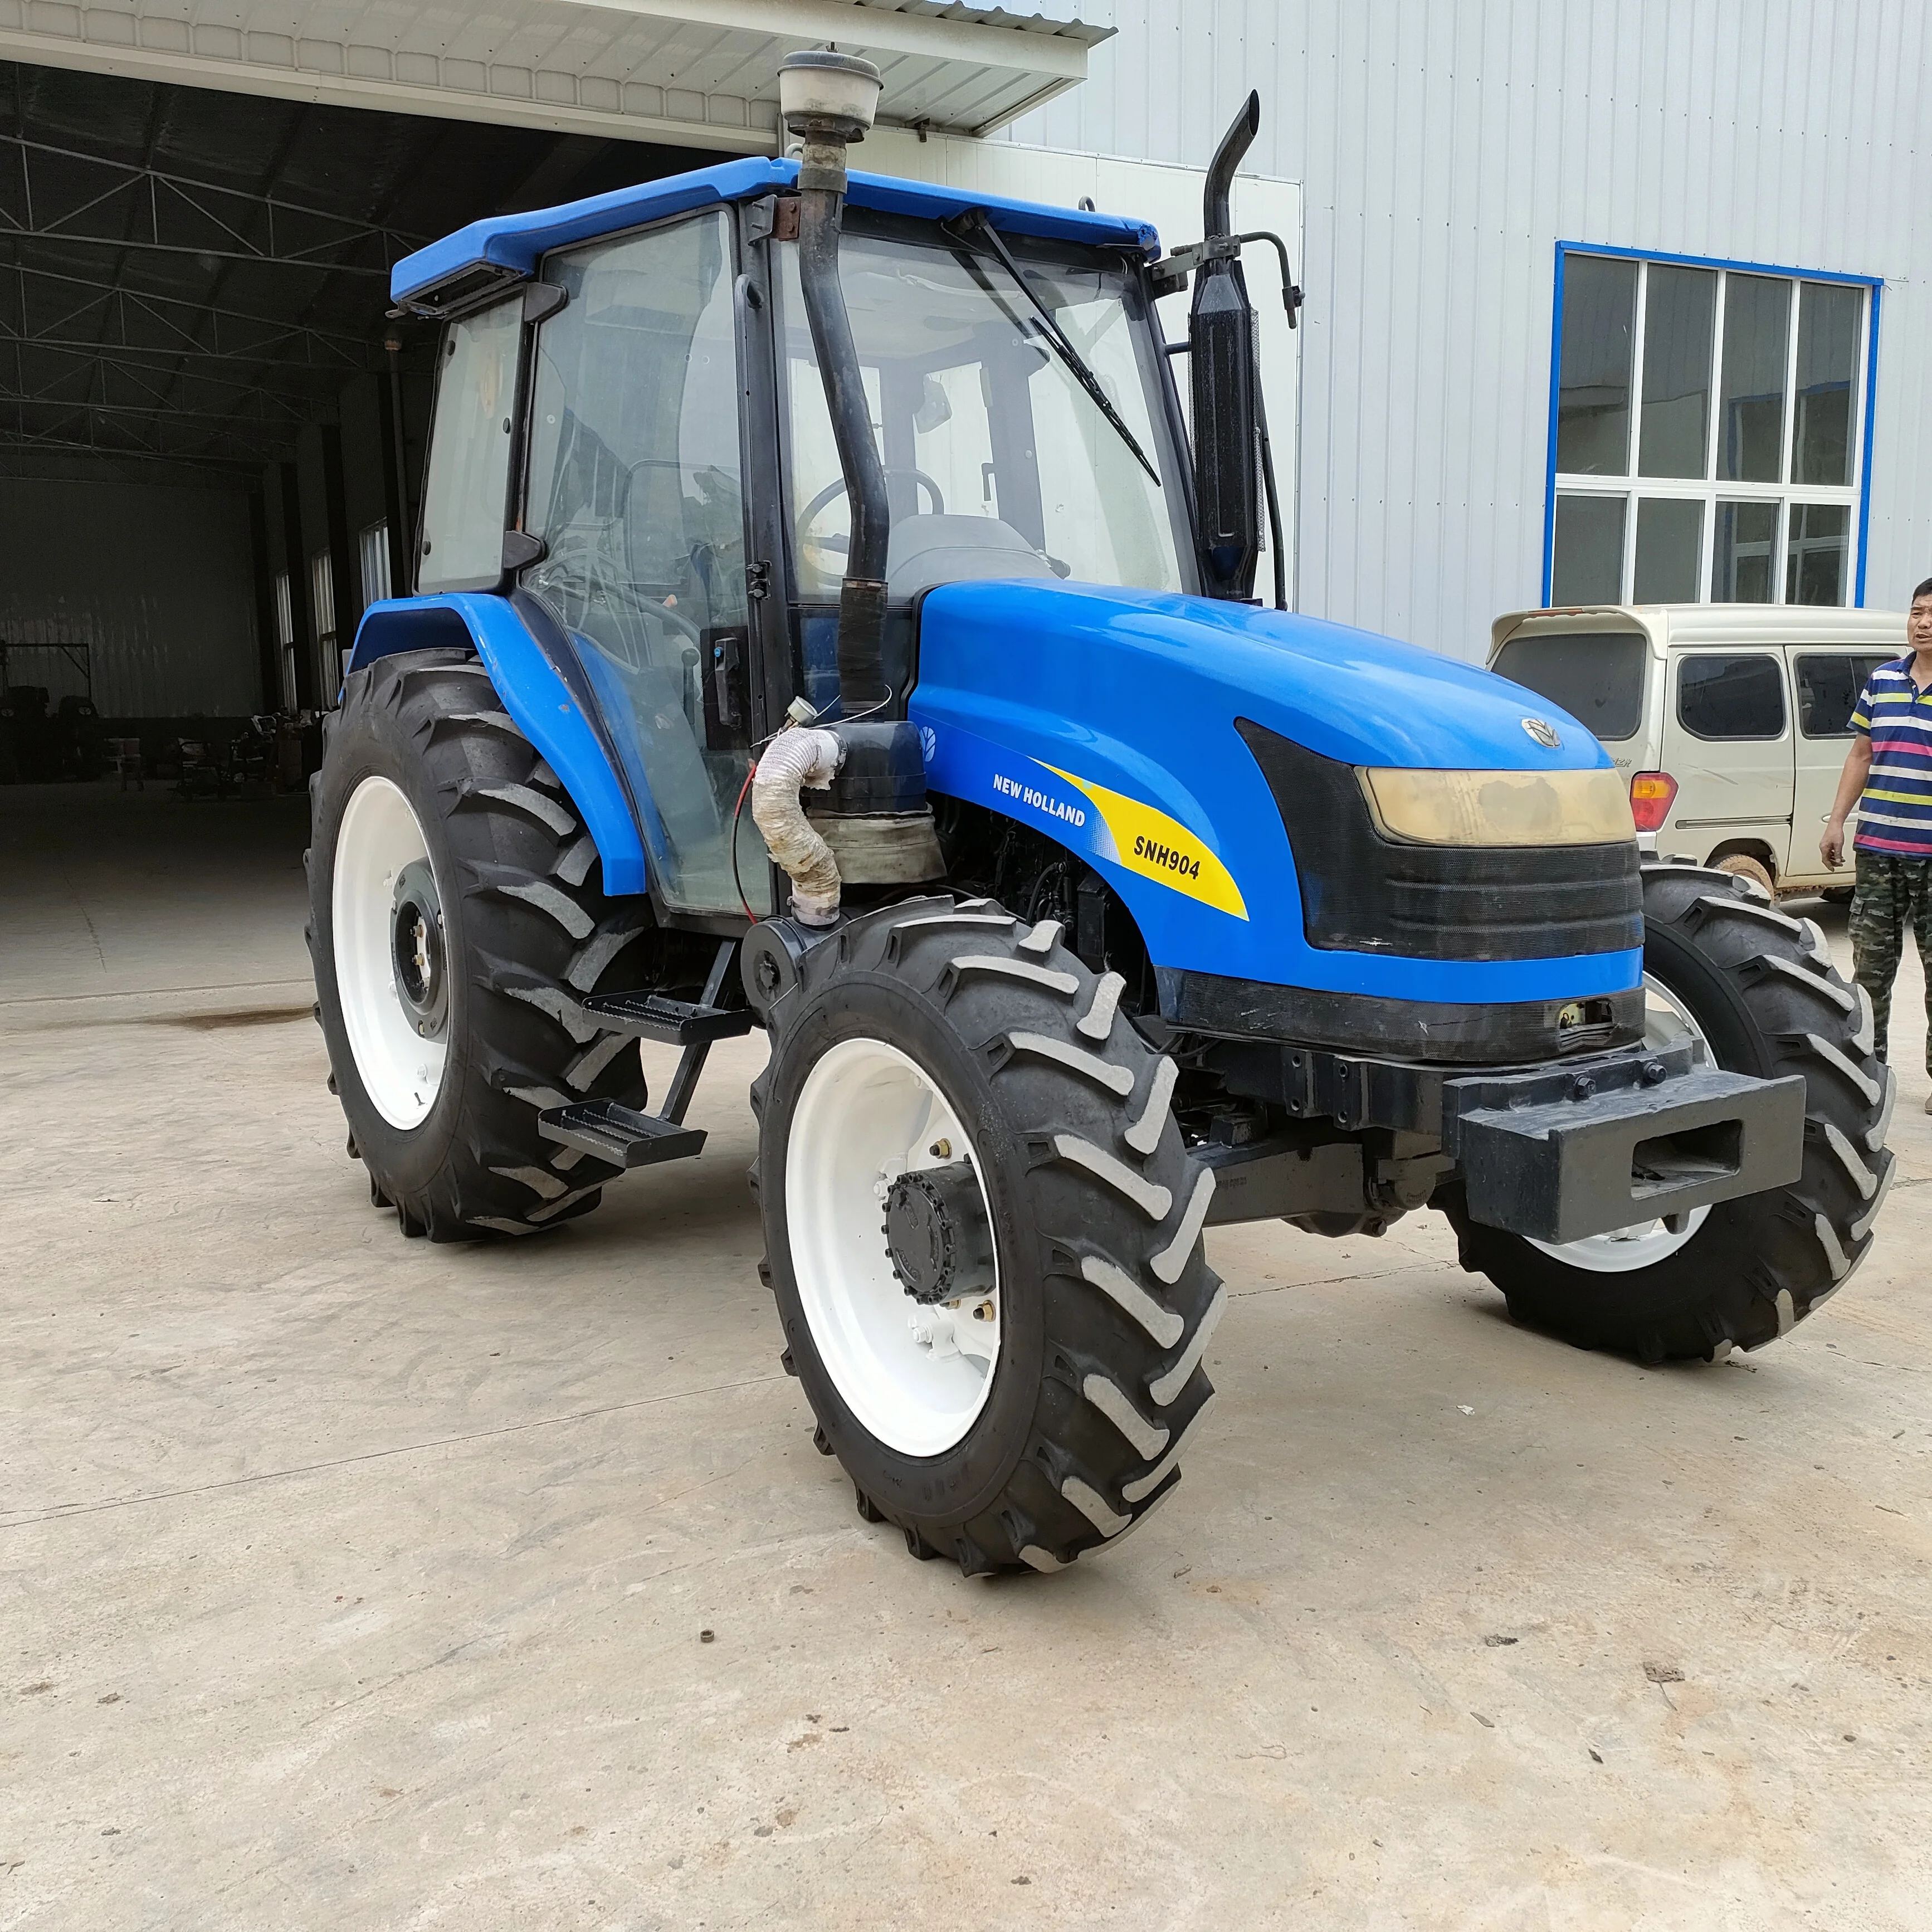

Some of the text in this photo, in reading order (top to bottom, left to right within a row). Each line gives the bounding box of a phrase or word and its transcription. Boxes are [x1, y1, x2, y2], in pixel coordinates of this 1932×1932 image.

[993, 773, 1085, 827] NEW HOLLAND
[1134, 836, 1201, 880] SNH904
